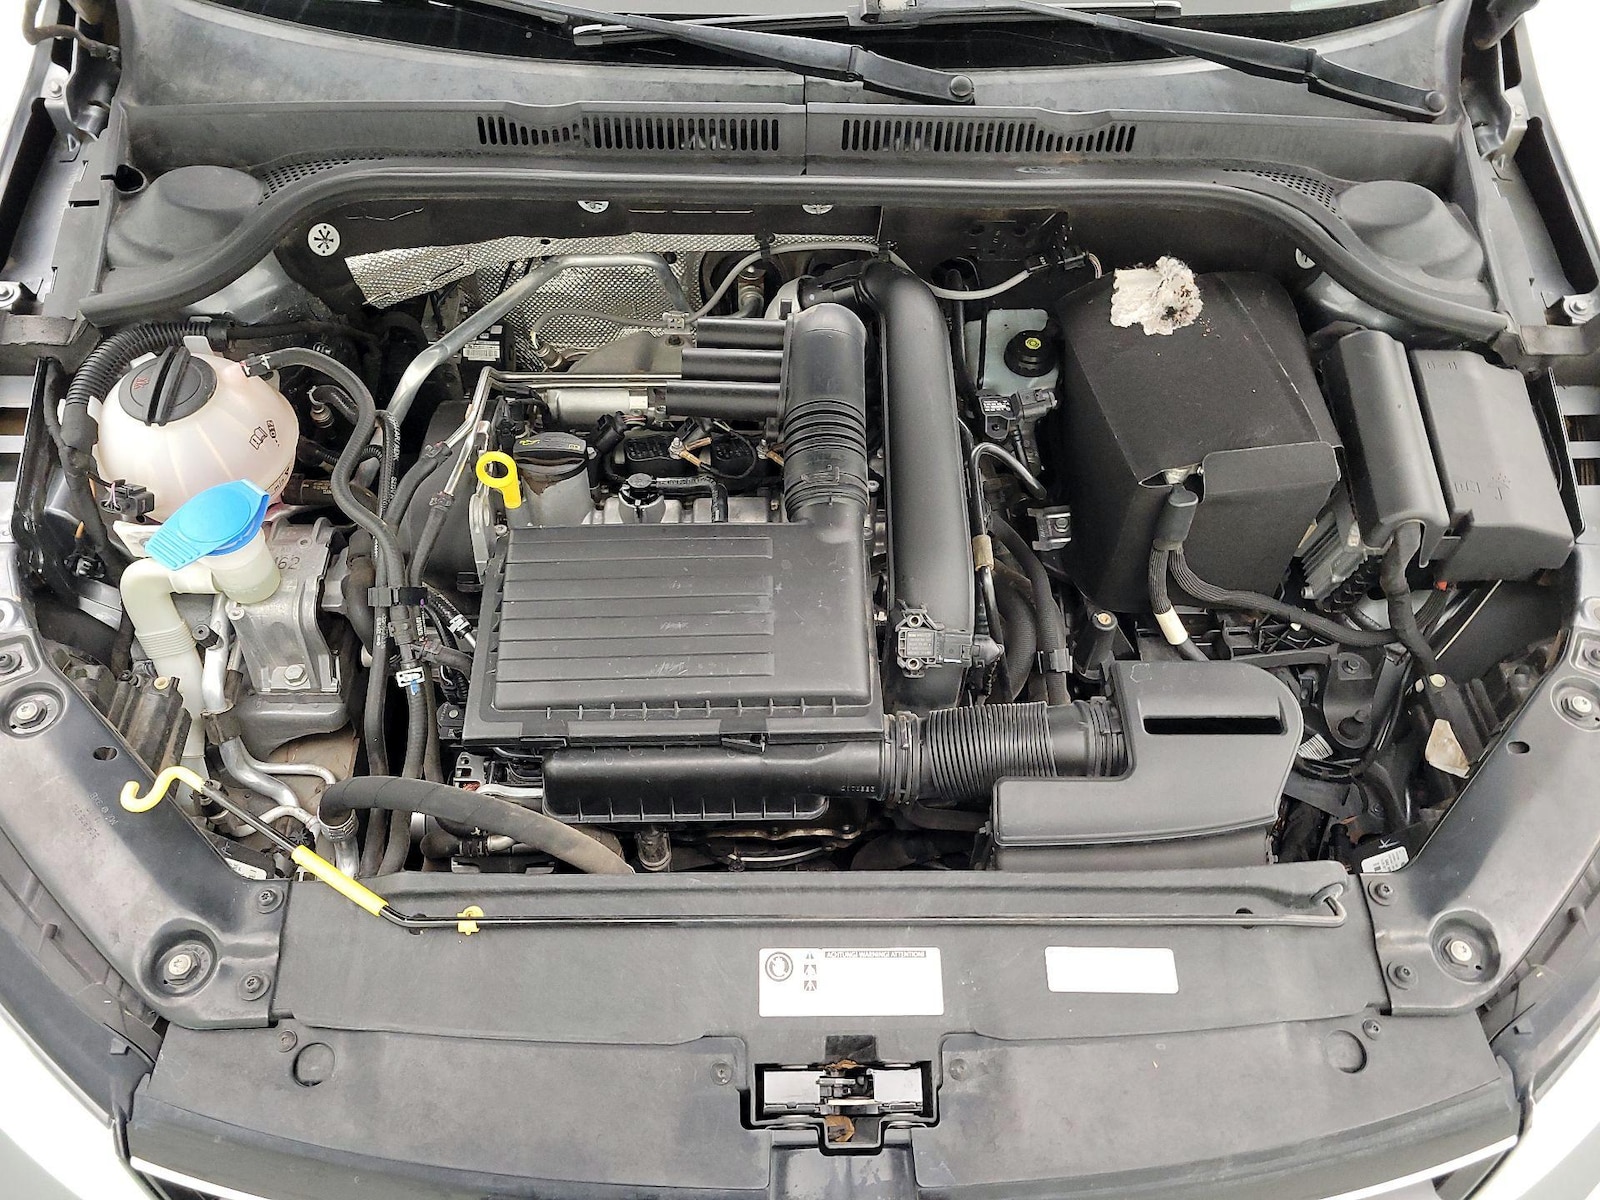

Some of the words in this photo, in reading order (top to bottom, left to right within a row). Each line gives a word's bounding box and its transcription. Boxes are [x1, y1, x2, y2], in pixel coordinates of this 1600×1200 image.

[826, 950, 857, 958] ACHTUNG!
[859, 950, 889, 958] WARNING!
[891, 950, 925, 958] ATTENTION!
